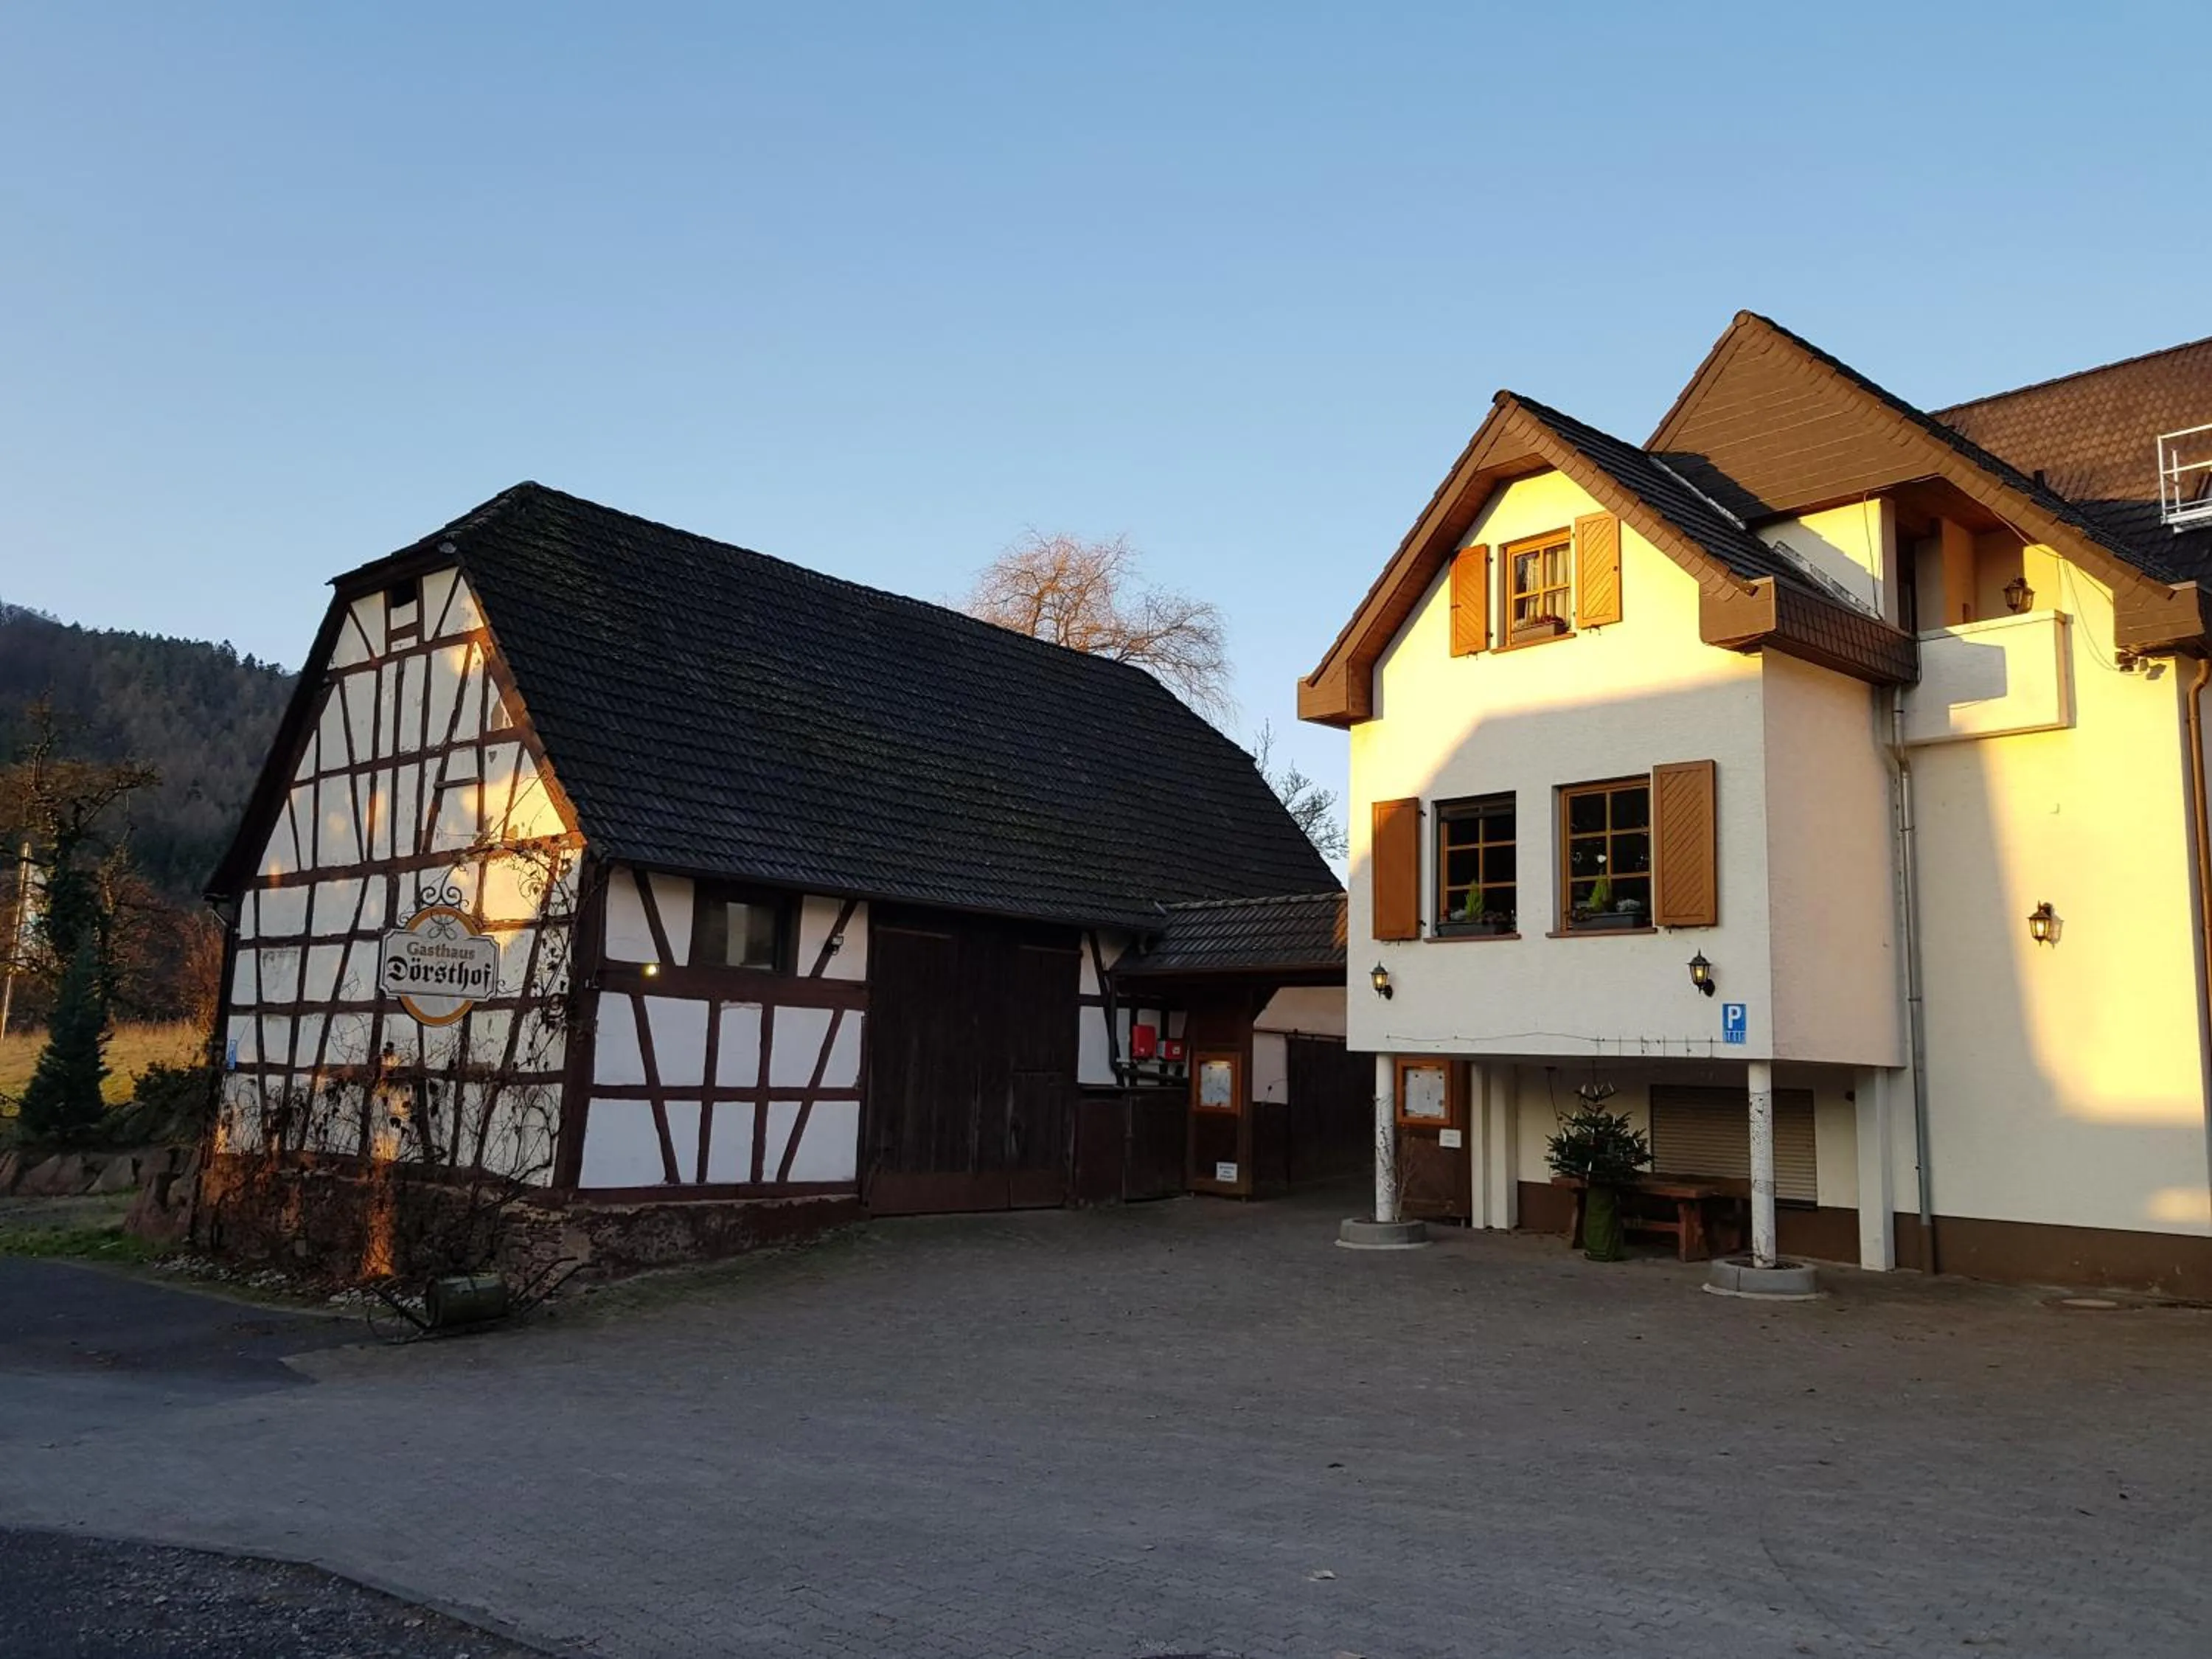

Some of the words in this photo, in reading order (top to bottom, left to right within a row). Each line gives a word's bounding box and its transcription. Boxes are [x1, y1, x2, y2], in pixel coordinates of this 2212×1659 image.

[407, 942, 476, 959] Gasthaus
[387, 956, 491, 992] Dörsthof
[1728, 1006, 1742, 1029] P
